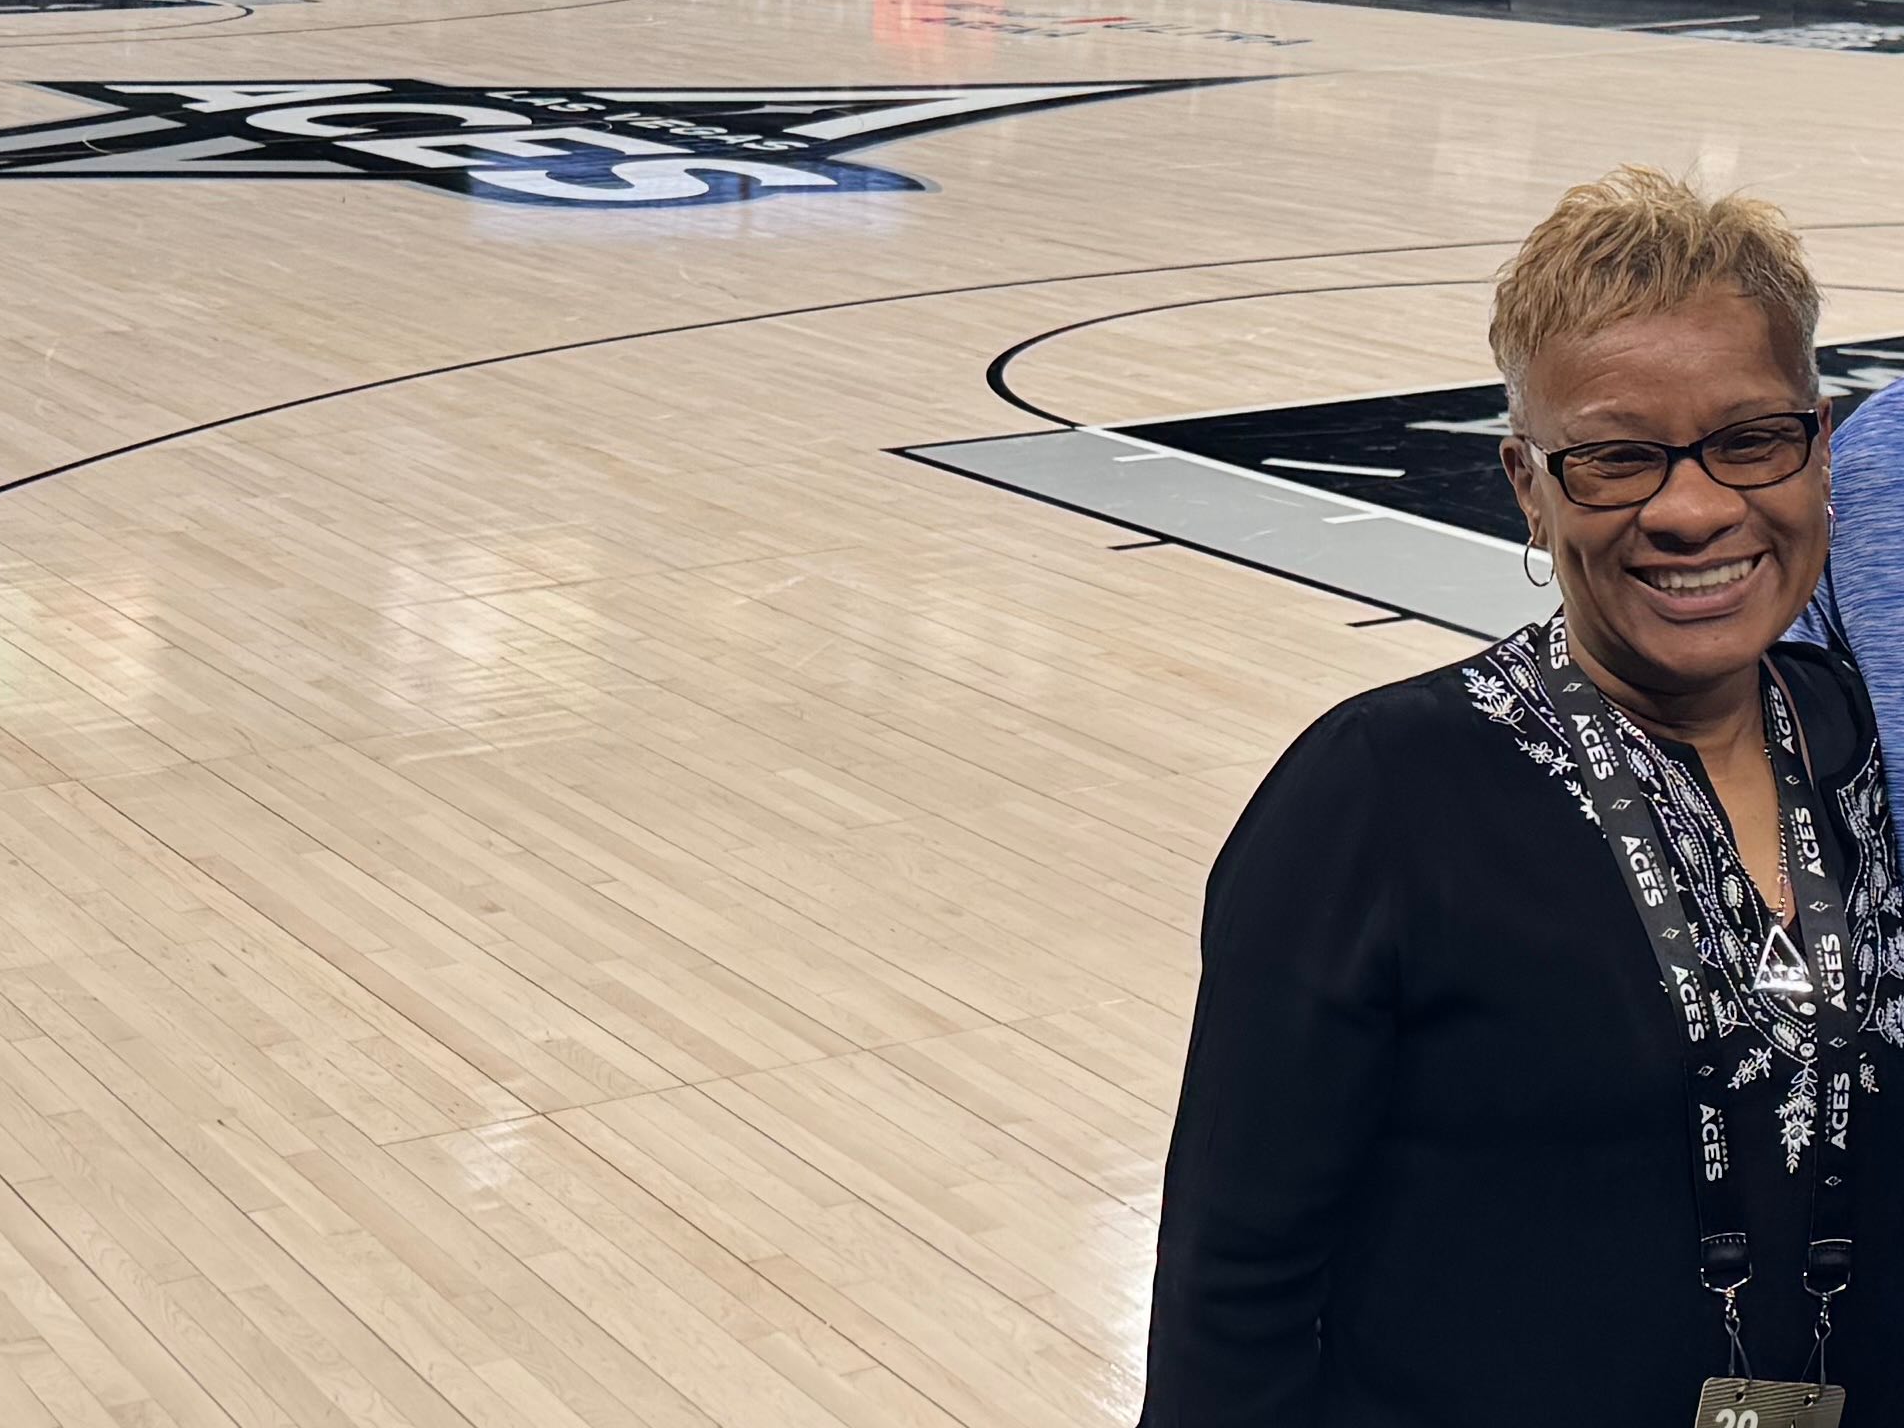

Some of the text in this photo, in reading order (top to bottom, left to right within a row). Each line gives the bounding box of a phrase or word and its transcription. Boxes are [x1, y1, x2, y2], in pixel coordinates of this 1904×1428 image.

[102, 81, 838, 203] ACES
[487, 90, 809, 152] LAS VEGAS
[1571, 713, 1615, 782] ACES
[1621, 835, 1666, 908] ACES
[1794, 807, 1826, 878] ACES
[1670, 964, 1706, 1043] ACES
[1821, 933, 1848, 1012] ACES
[1699, 1103, 1723, 1182] ACES
[1830, 1072, 1852, 1150] ACES
